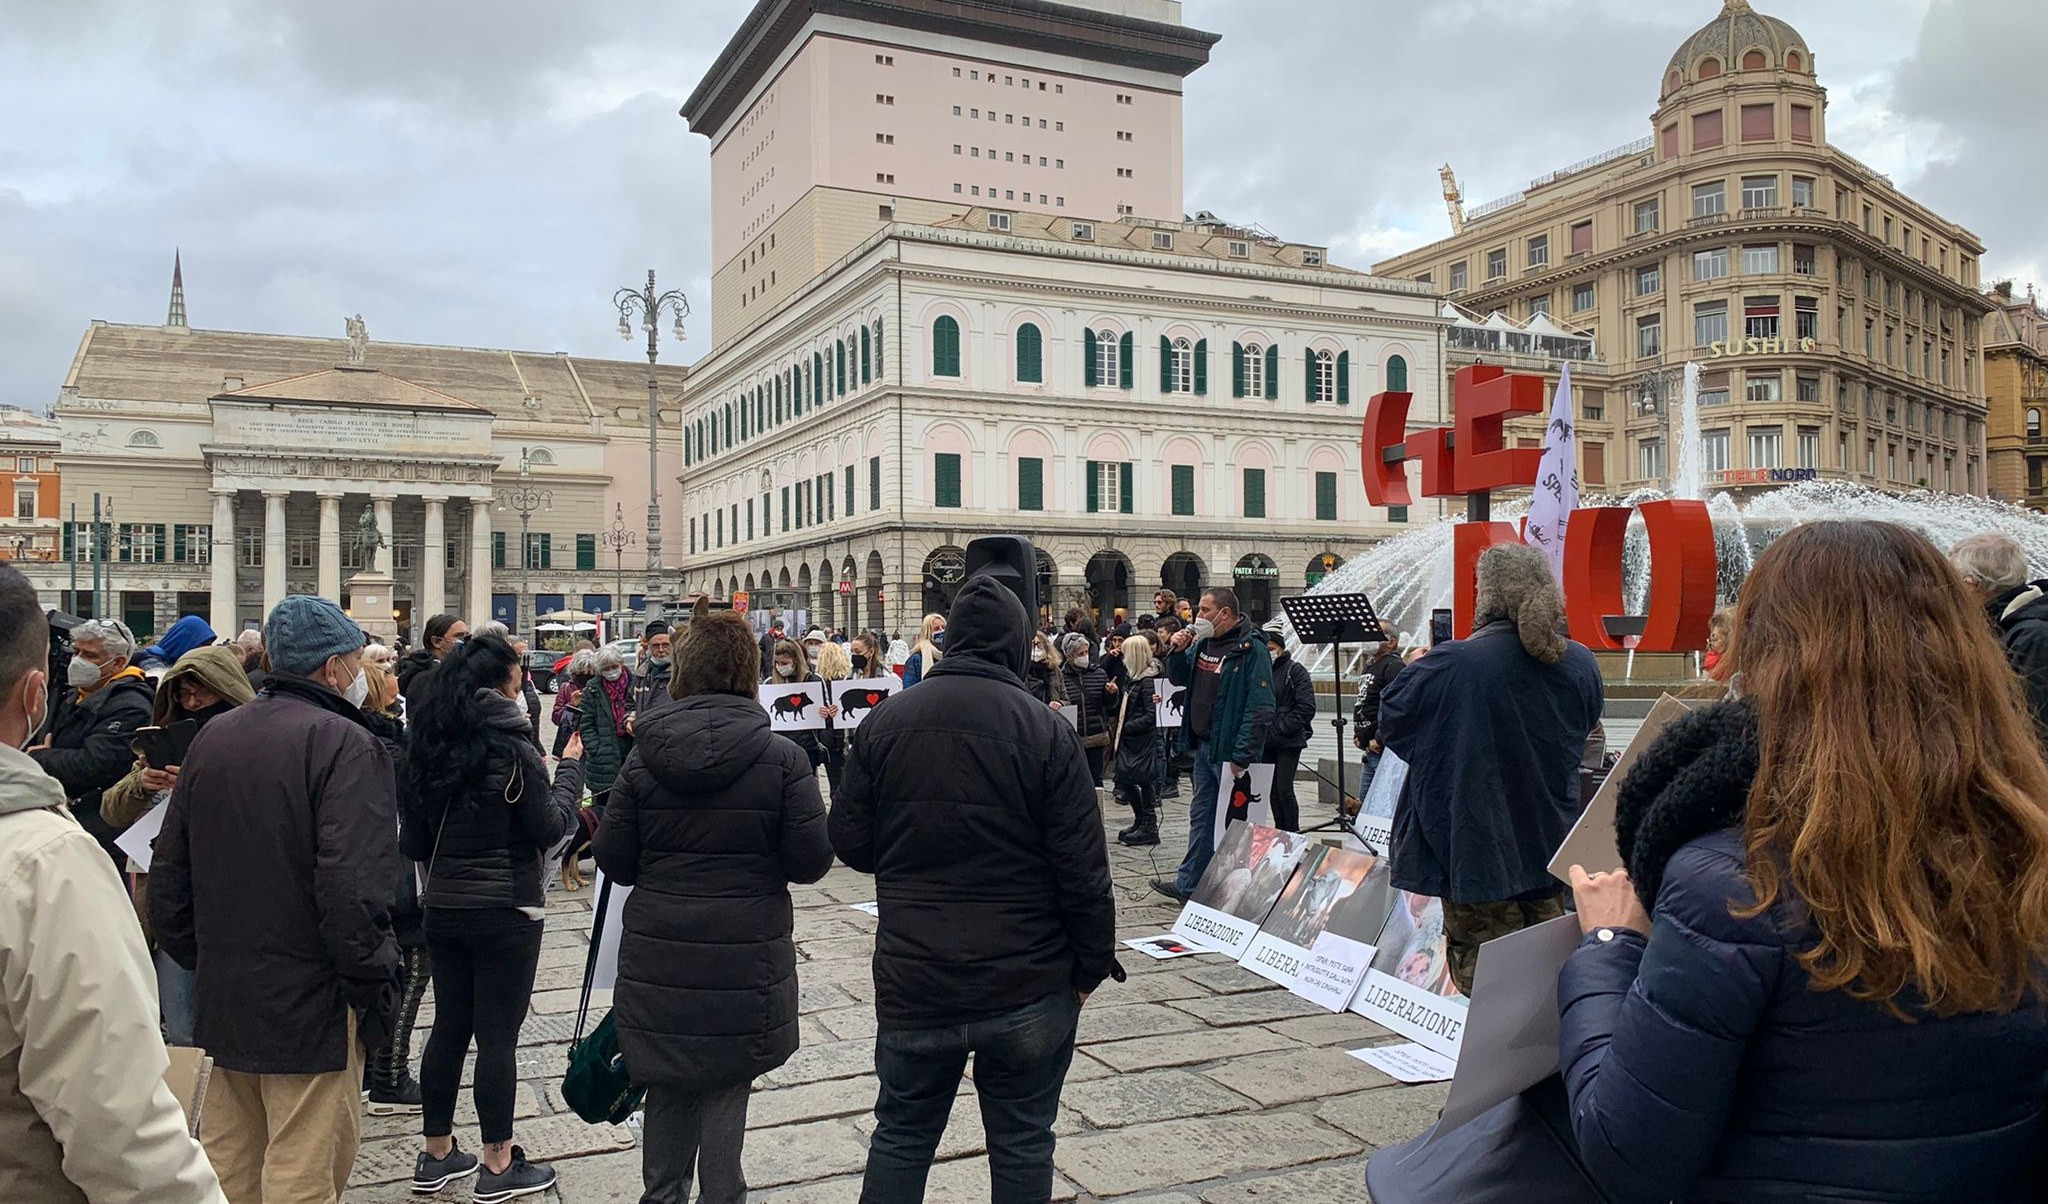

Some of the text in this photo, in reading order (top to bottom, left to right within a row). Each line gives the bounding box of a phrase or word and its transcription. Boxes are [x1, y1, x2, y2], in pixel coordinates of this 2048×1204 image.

[1710, 336, 1790, 358] SUSHI
[1724, 468, 1817, 485] TELE NORD
[1235, 567, 1278, 575] PATEK PHILIPPE
[1184, 912, 1244, 946] LIBERAZIONE
[1255, 945, 1300, 978] LIBERA
[1364, 984, 1462, 1042] LIBERAZIONE
